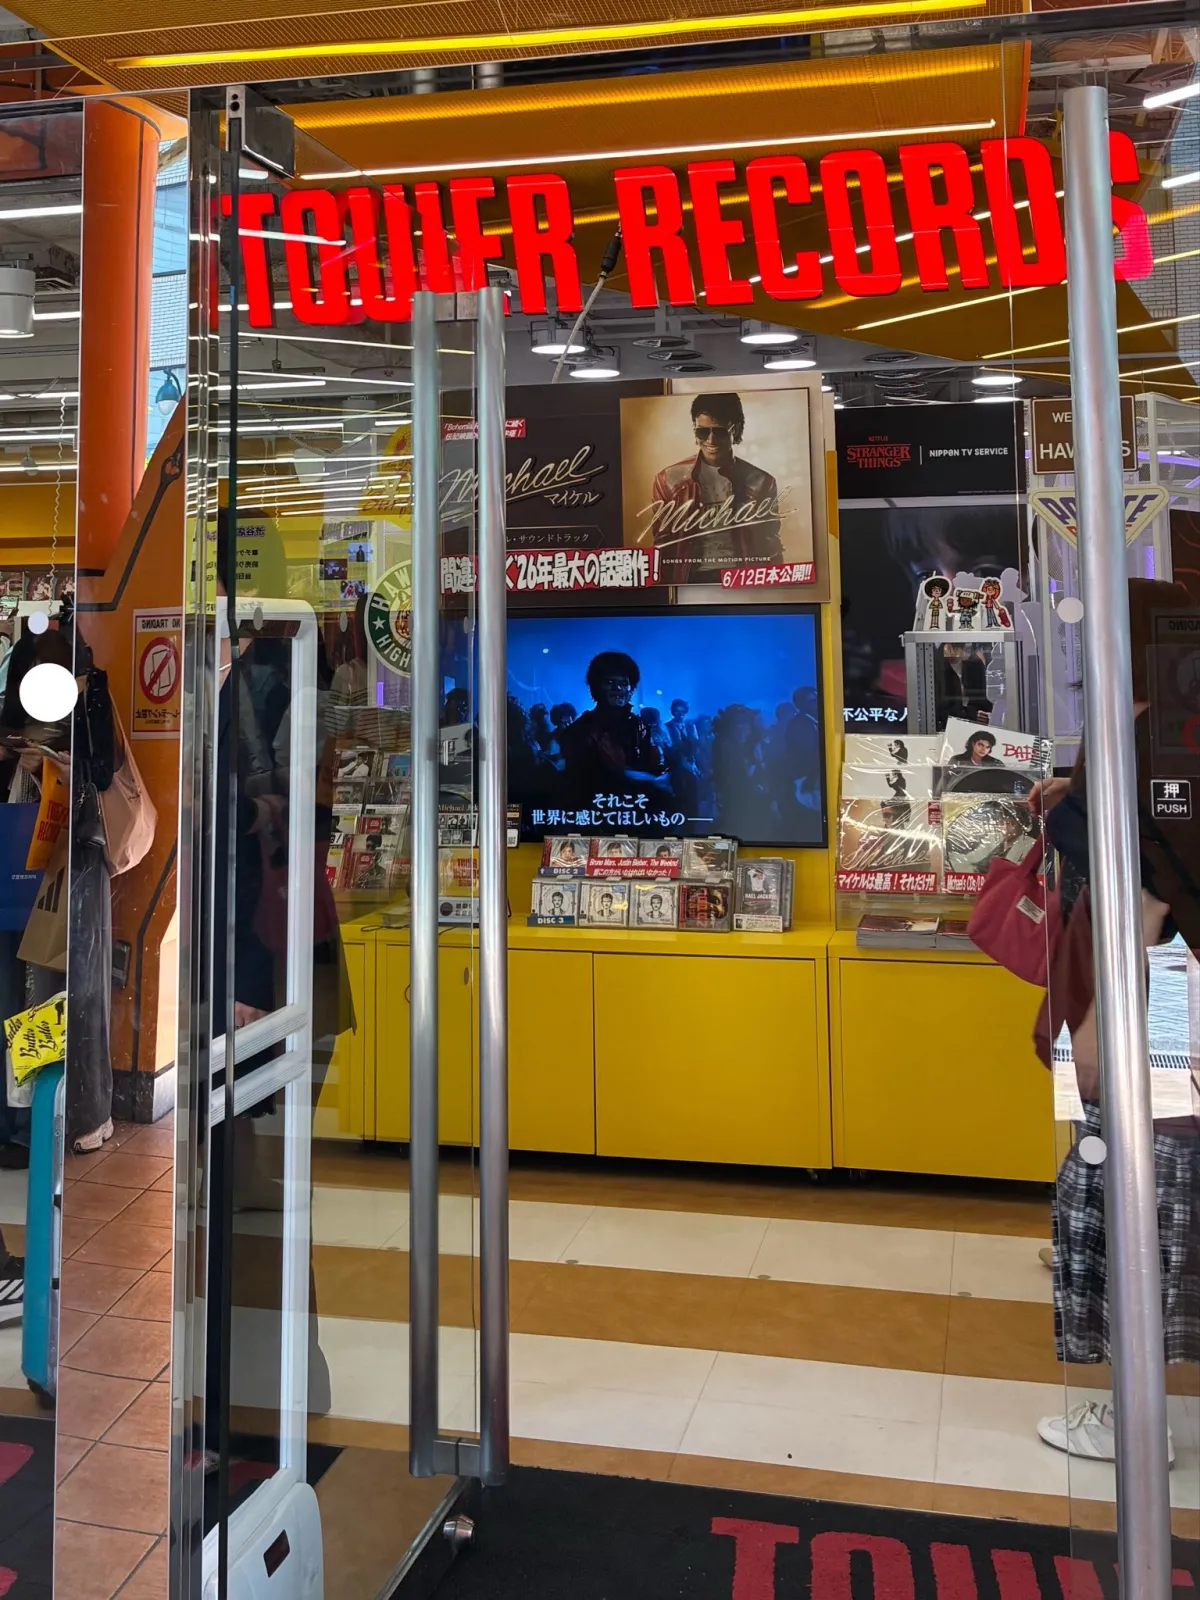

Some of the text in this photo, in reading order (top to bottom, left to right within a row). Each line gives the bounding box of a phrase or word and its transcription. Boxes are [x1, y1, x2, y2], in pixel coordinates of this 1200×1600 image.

[221, 172, 582, 328] TOWER
[846, 445, 912, 461] STRANGER
[961, 448, 973, 457] TV
[974, 447, 1009, 456] SERVICE
[857, 456, 901, 469] THINGS
[543, 489, 600, 506] マイケル
[635, 486, 798, 545] Michael
[440, 549, 660, 594] 間違く'26年最大の話題作！
[375, 633, 411, 668] HIGH
[1162, 783, 1180, 799] 押
[592, 793, 649, 809] それこそ
[1156, 803, 1187, 813] PUSH
[537, 917, 555, 925] DISC
